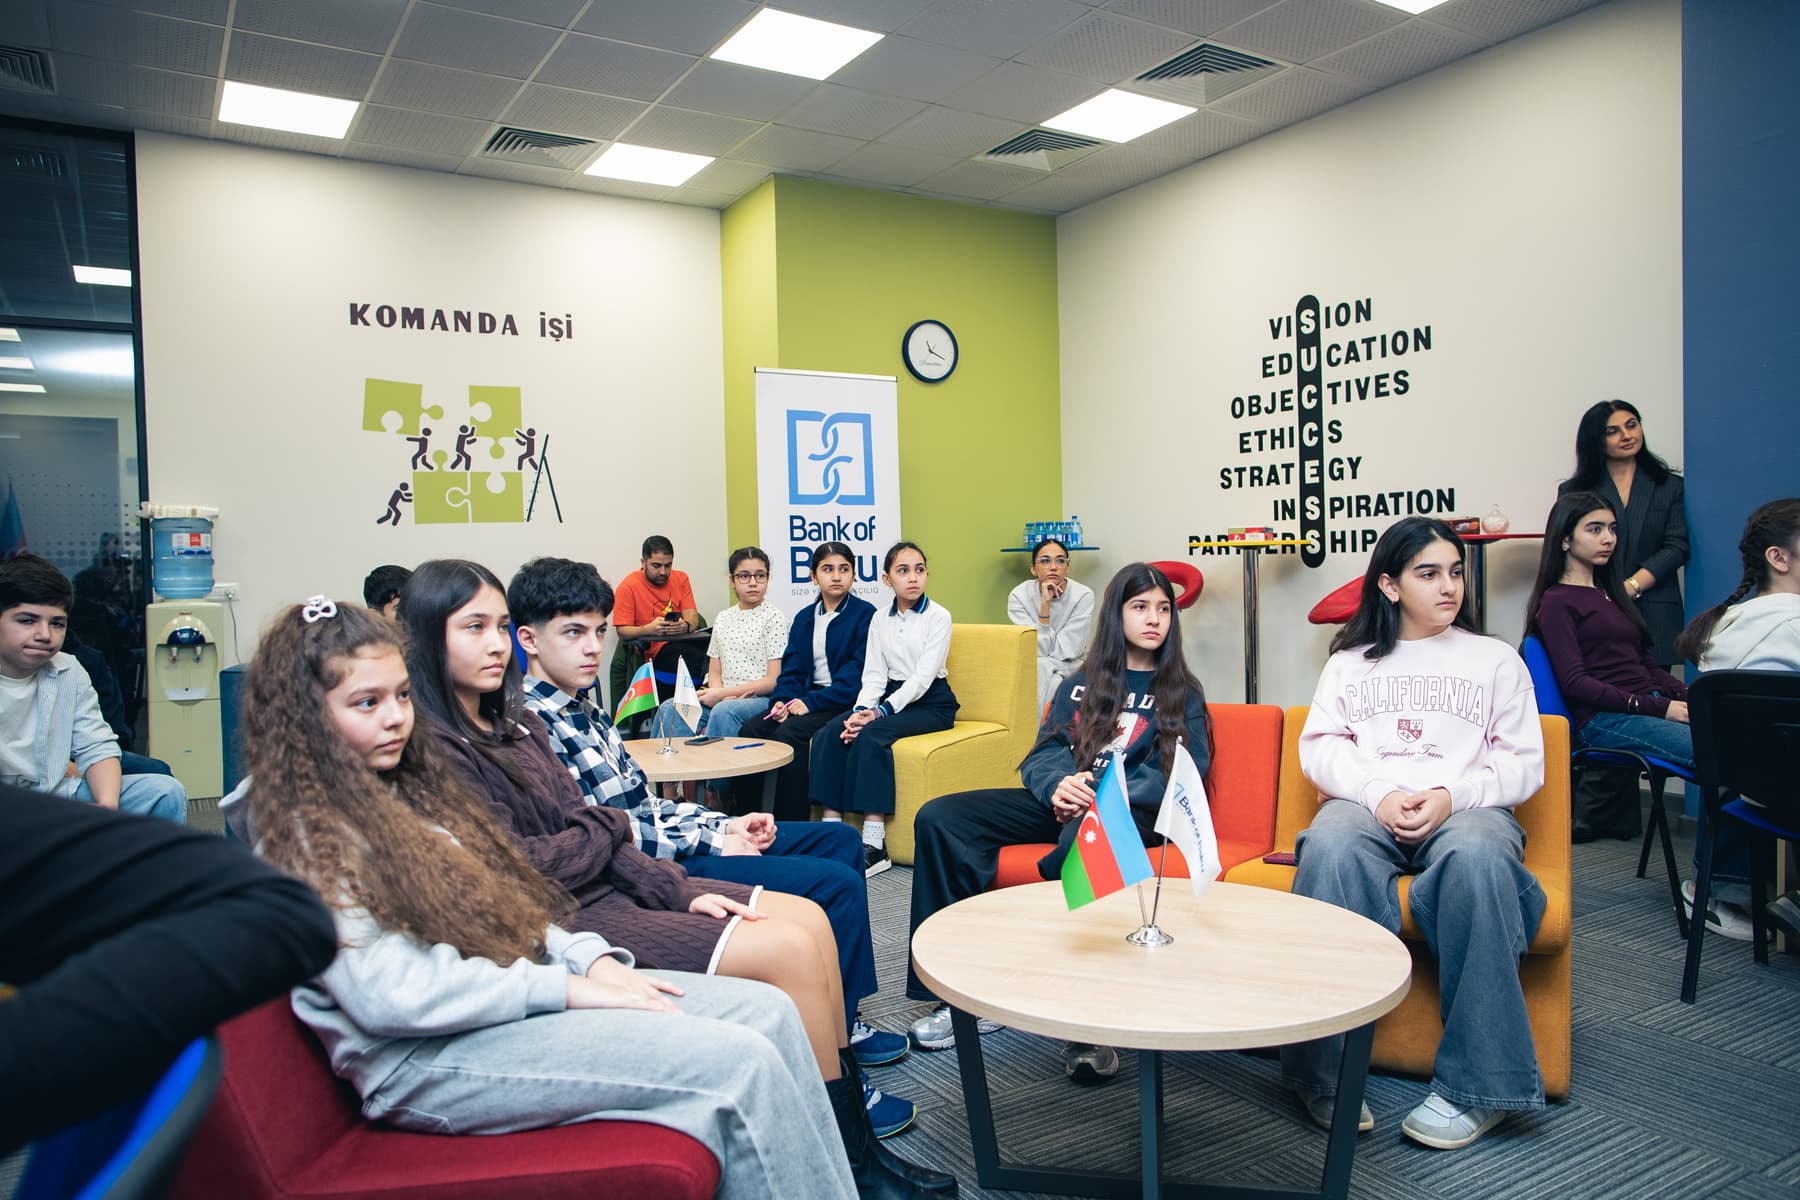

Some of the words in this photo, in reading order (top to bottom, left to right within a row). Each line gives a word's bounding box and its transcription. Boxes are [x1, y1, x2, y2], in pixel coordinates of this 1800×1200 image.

[350, 303, 519, 336] KOMANDA
[1269, 297, 1372, 340] VISION
[1262, 326, 1432, 378] EDUCATION
[1231, 369, 1409, 419] OBJECTIVES
[1239, 419, 1342, 454] ETHICS
[1220, 456, 1362, 490] STRATEGY
[1273, 487, 1455, 521] INSPIRATION
[789, 515, 851, 542] Bank
[853, 515, 876, 541] of
[790, 546, 878, 584] Bu
[1346, 675, 1485, 728] CALIFORNIA
[1417, 743, 1444, 759] Team
